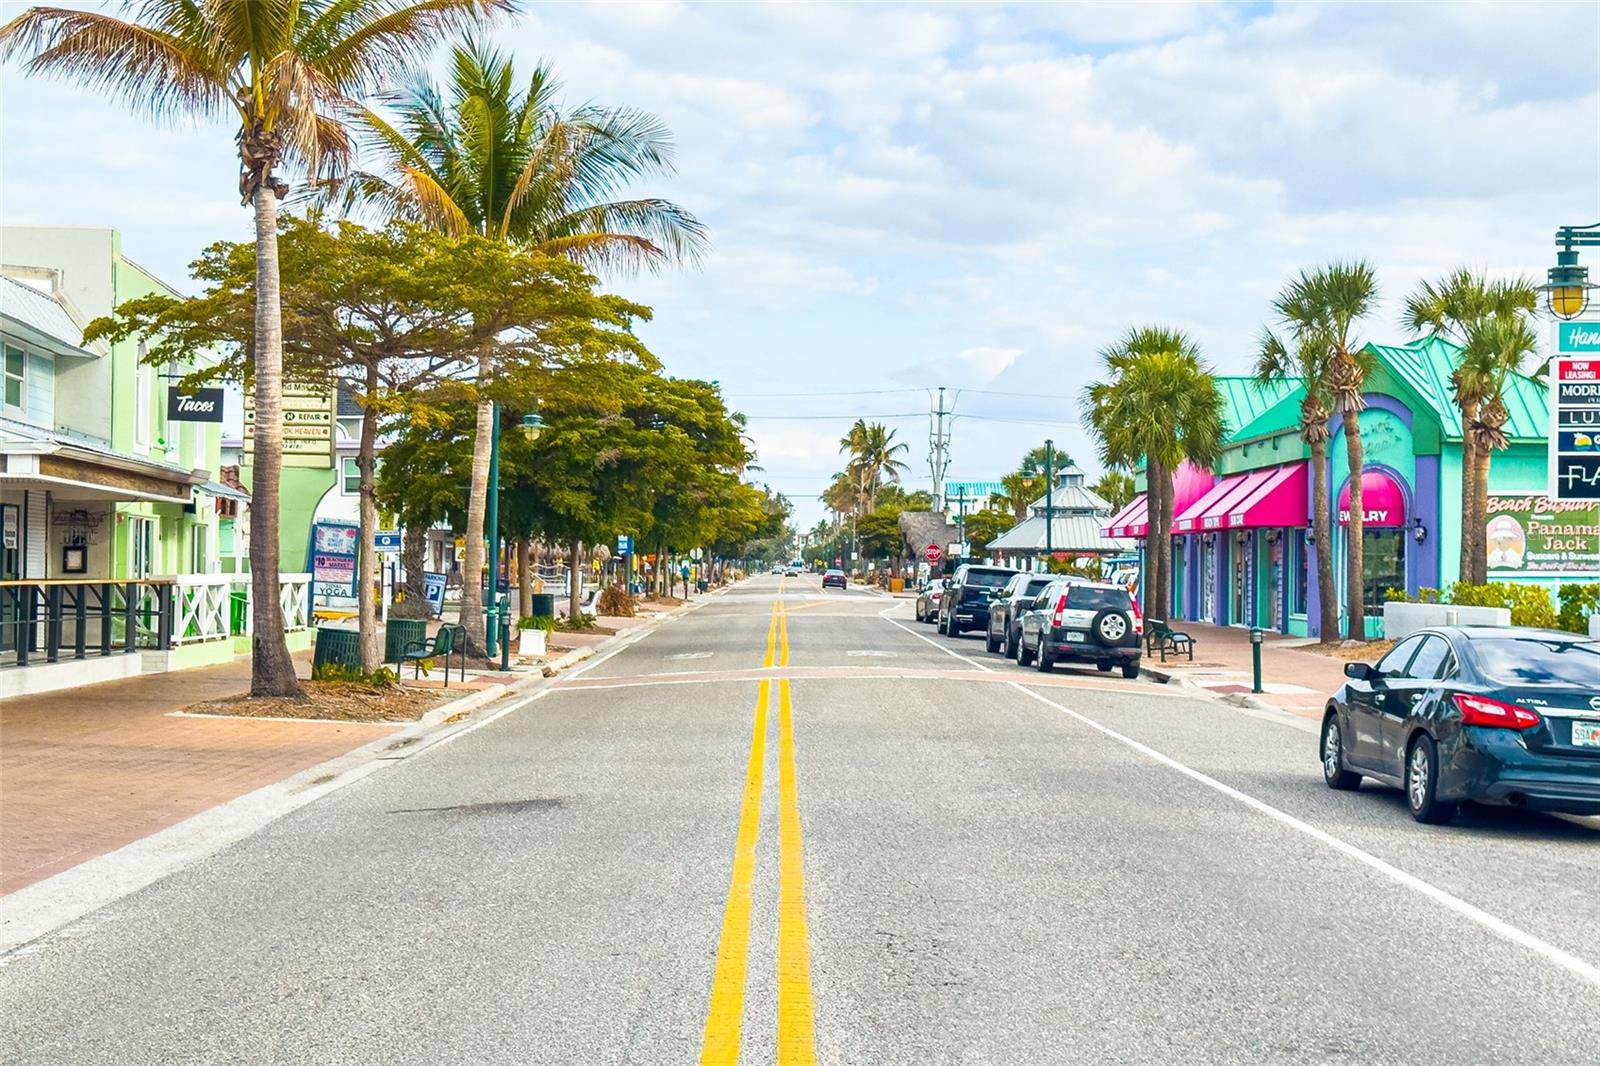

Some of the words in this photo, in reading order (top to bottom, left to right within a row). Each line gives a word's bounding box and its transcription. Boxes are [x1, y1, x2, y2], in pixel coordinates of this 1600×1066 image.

[1572, 362, 1590, 370] NOW
[176, 395, 215, 412] Tacos
[1486, 496, 1534, 513] Beach
[1527, 521, 1600, 535] Panama
[1543, 535, 1587, 550] Jack
[320, 587, 347, 597] YOGA
